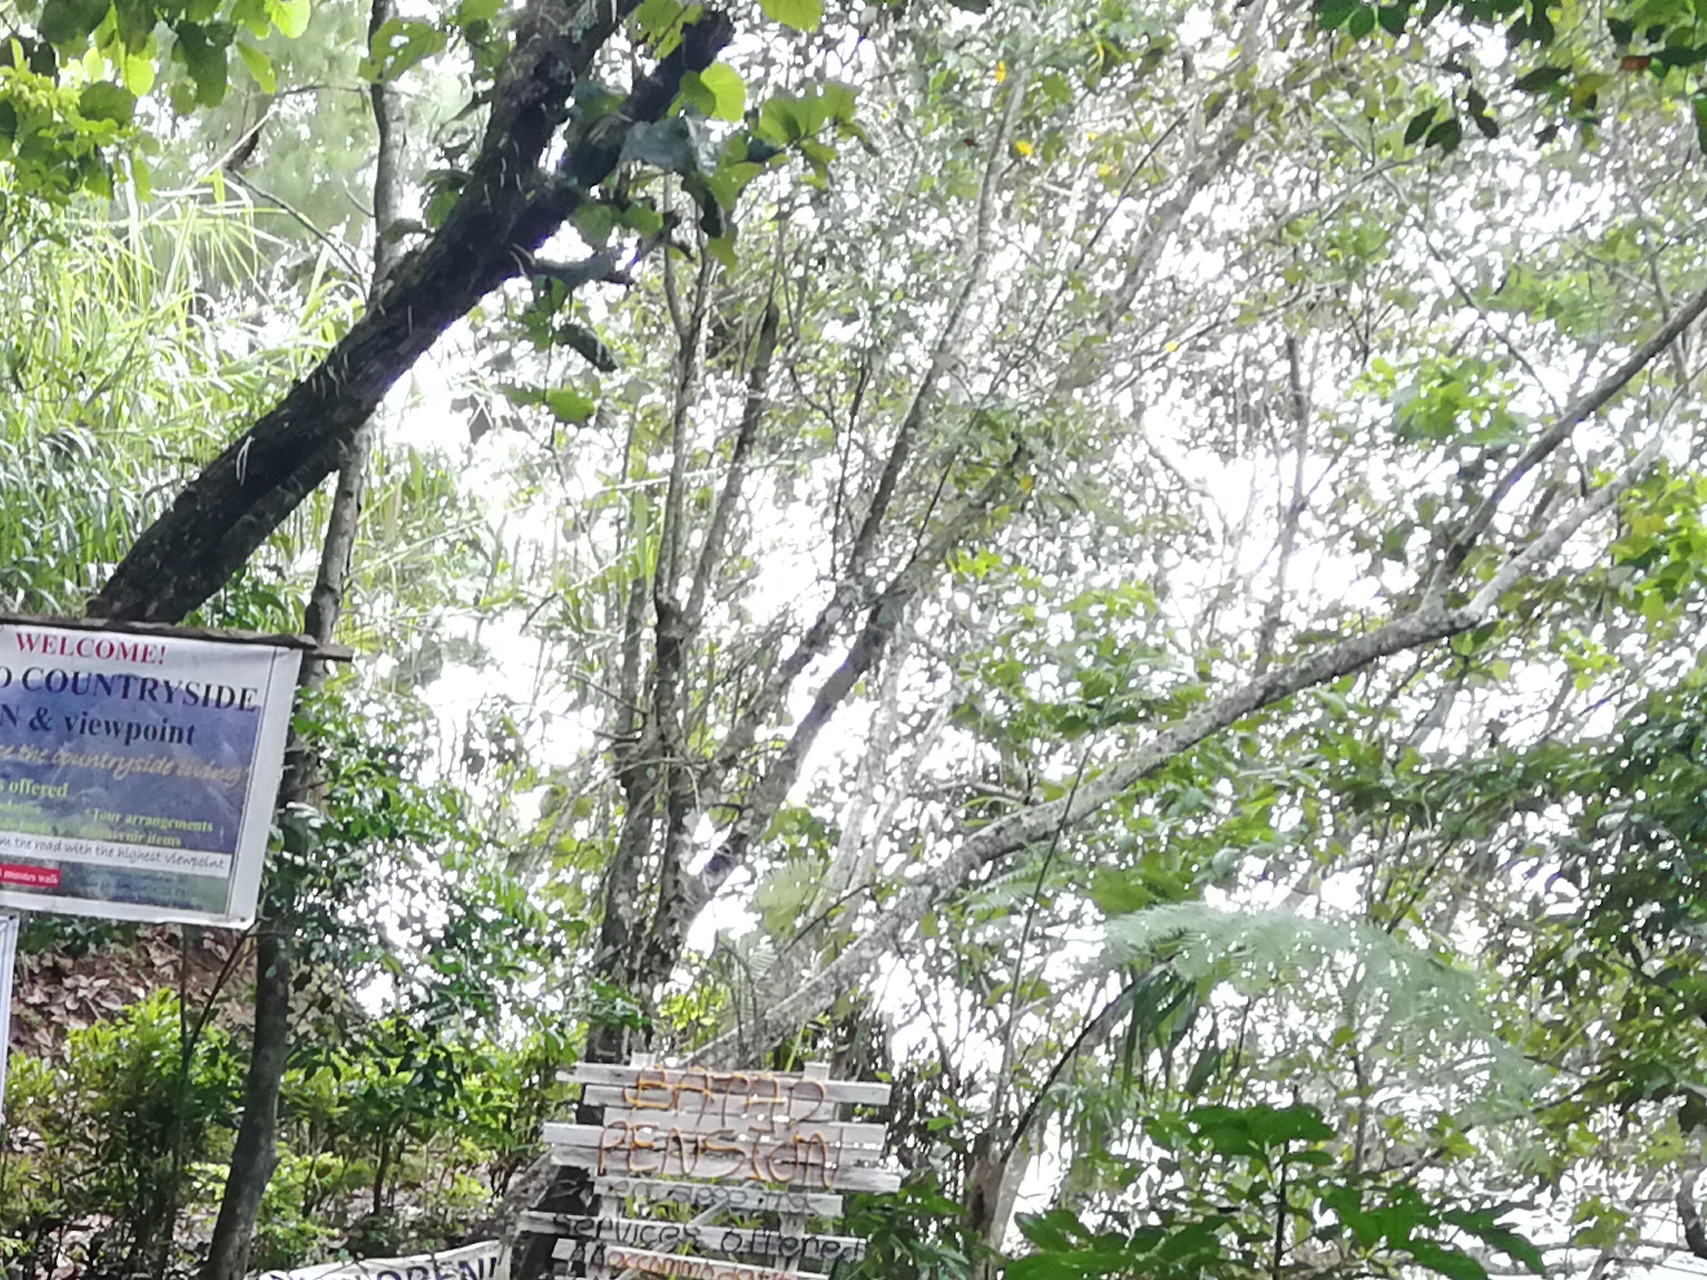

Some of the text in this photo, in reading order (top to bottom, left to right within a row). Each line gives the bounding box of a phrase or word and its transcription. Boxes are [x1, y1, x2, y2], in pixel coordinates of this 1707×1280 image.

[16, 632, 166, 665] WELCOME!
[21, 666, 259, 712] COUNTRYSIDE
[28, 706, 53, 731] &
[64, 710, 196, 746] viewpoint
[9, 778, 69, 798] offered
[125, 813, 213, 833] arrangements
